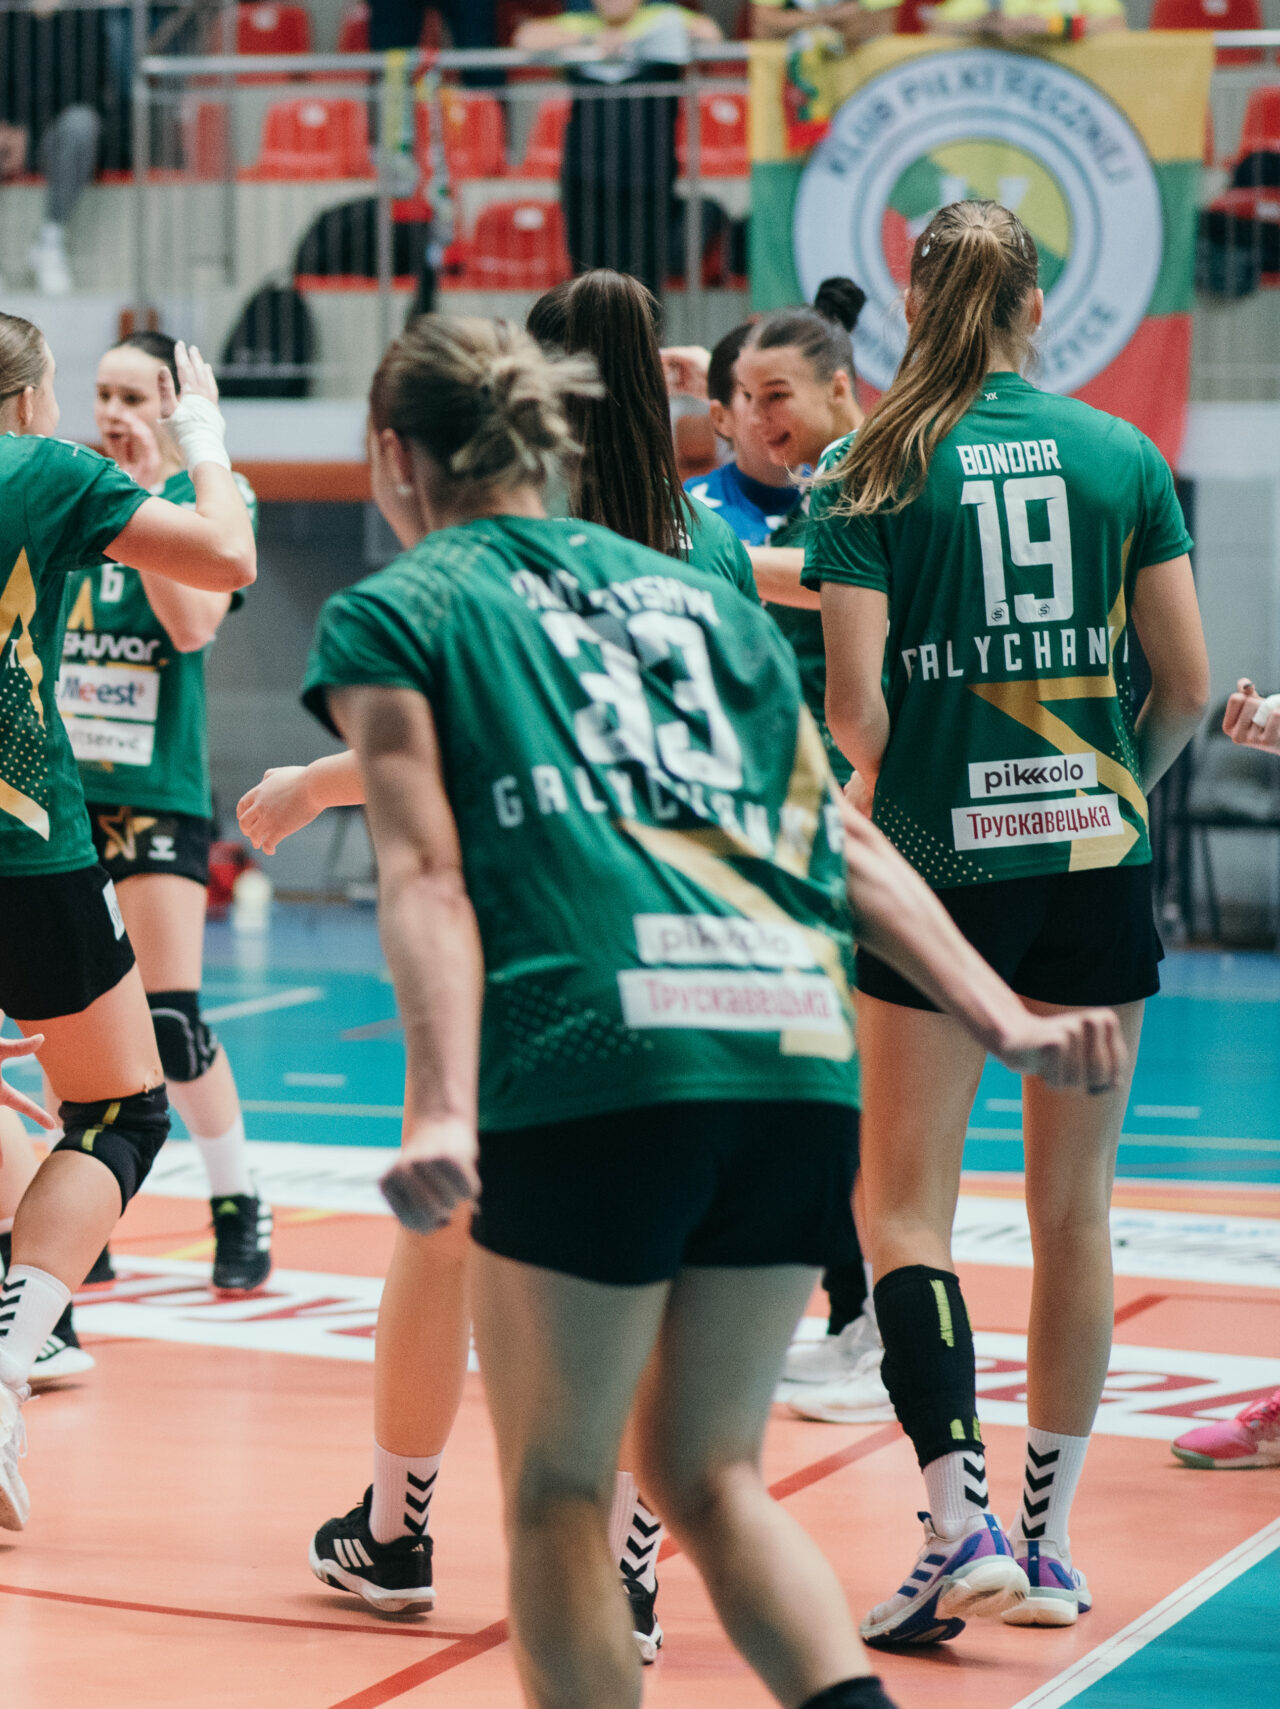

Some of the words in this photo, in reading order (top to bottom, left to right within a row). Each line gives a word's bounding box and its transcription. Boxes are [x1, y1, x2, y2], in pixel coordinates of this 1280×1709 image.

[956, 439, 1062, 476] BONDAR
[961, 475, 1074, 627] 19
[540, 610, 743, 790] 33
[967, 805, 1111, 840] Трускавецька
